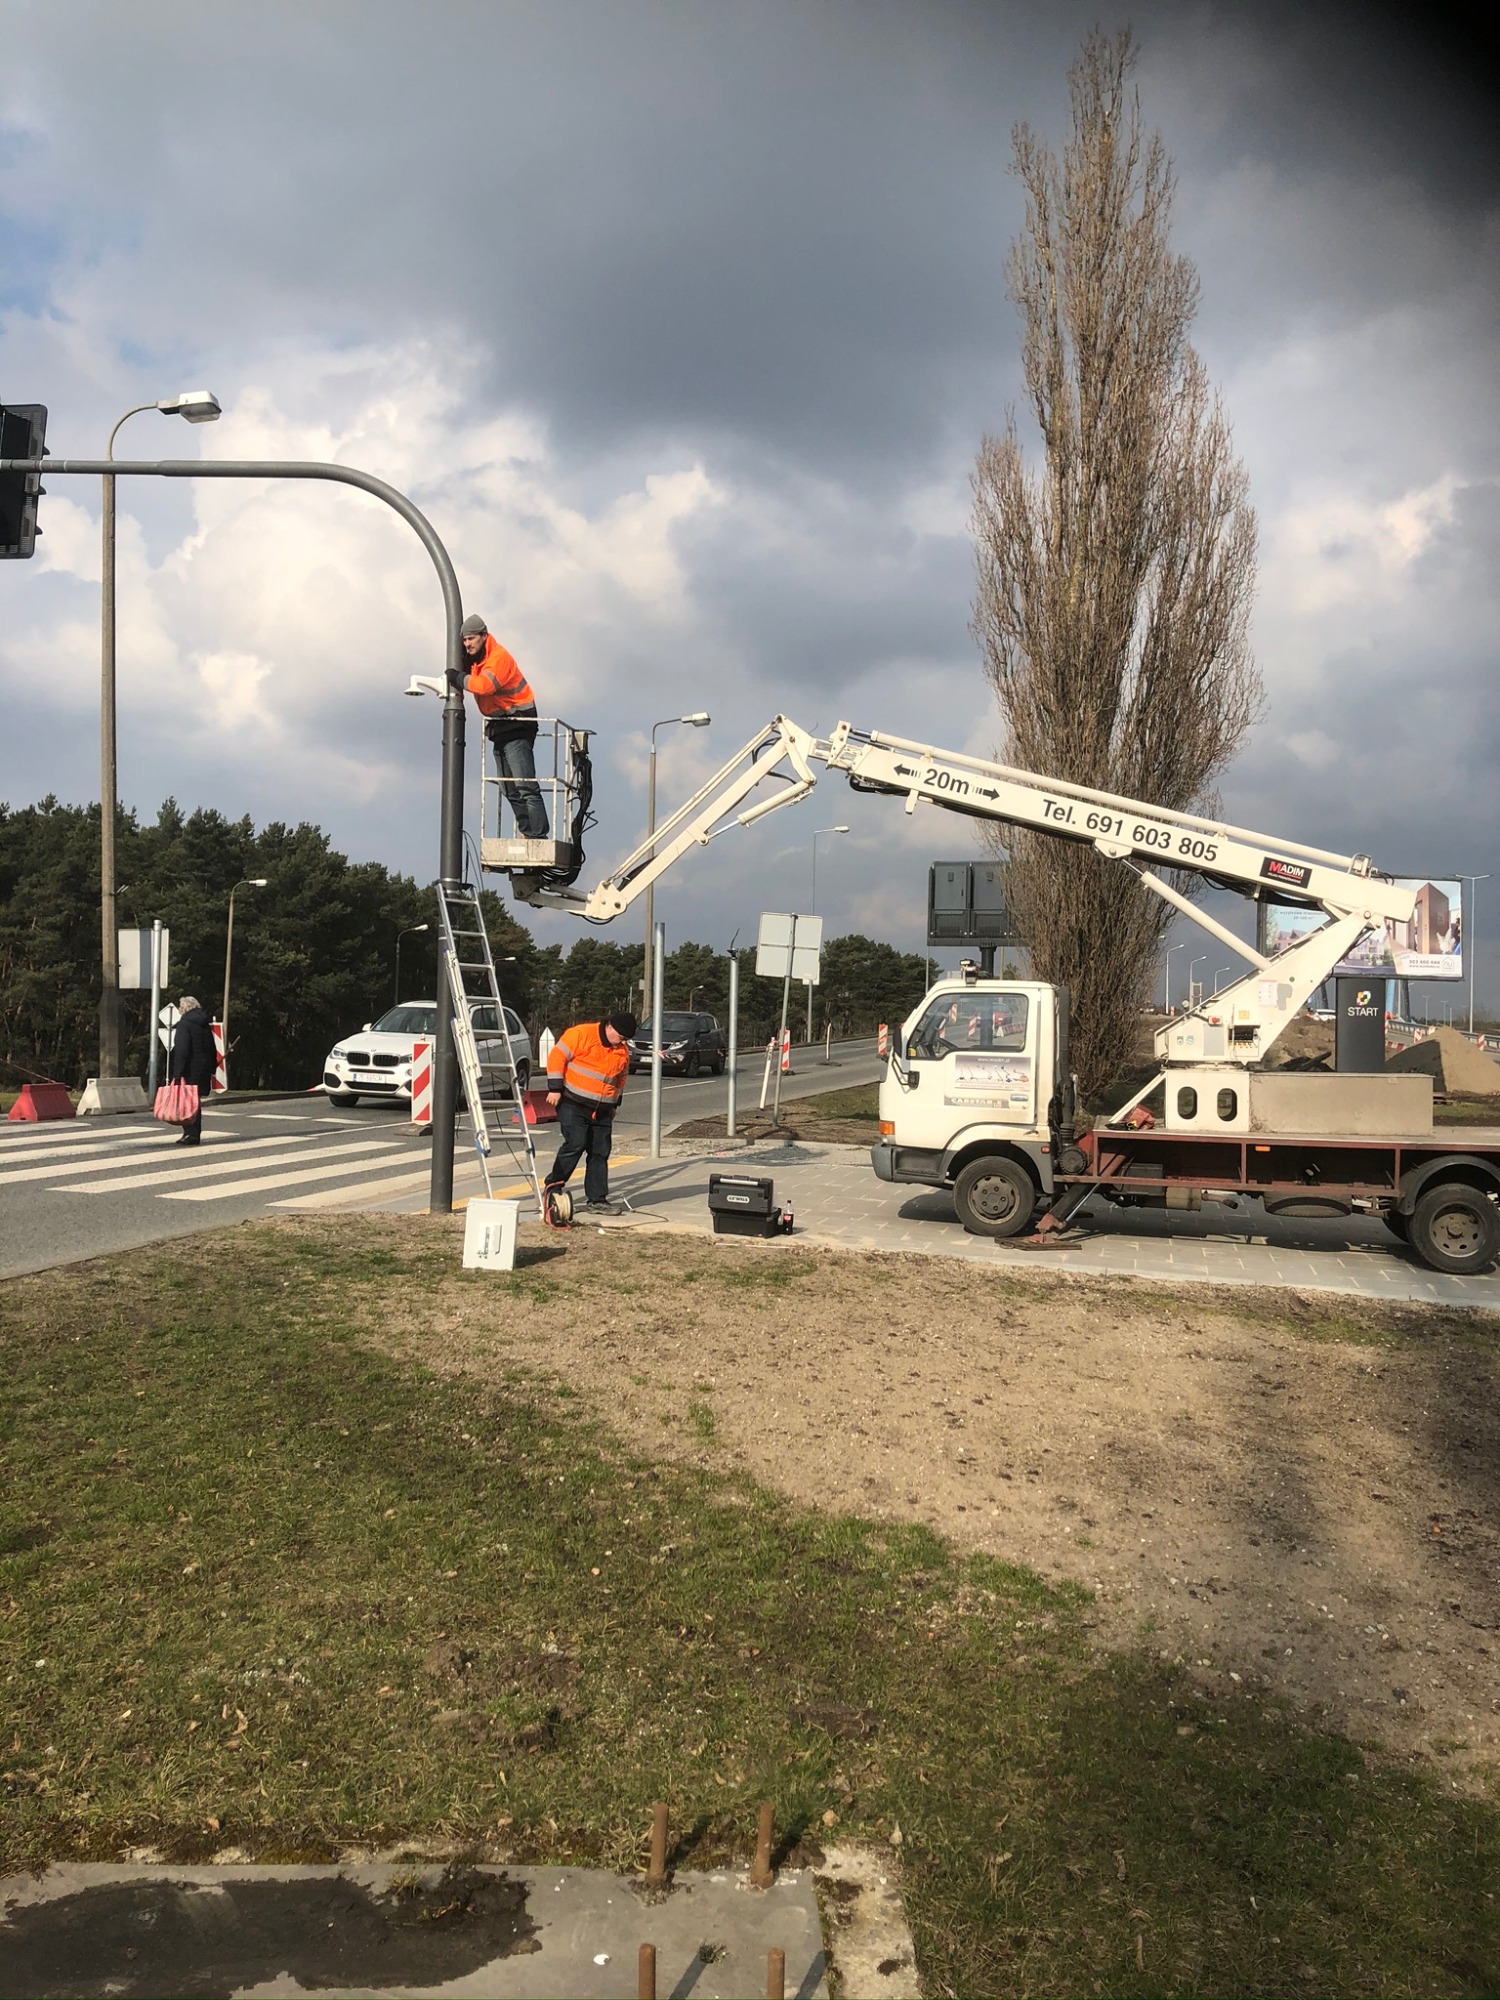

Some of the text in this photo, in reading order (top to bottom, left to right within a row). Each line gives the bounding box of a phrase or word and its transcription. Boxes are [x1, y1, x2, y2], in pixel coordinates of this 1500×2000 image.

[923, 768, 970, 795] 20m
[1042, 799, 1219, 862] Tel. 691 603 805
[1269, 860, 1305, 878] MADIM
[1347, 1007, 1378, 1016] START
